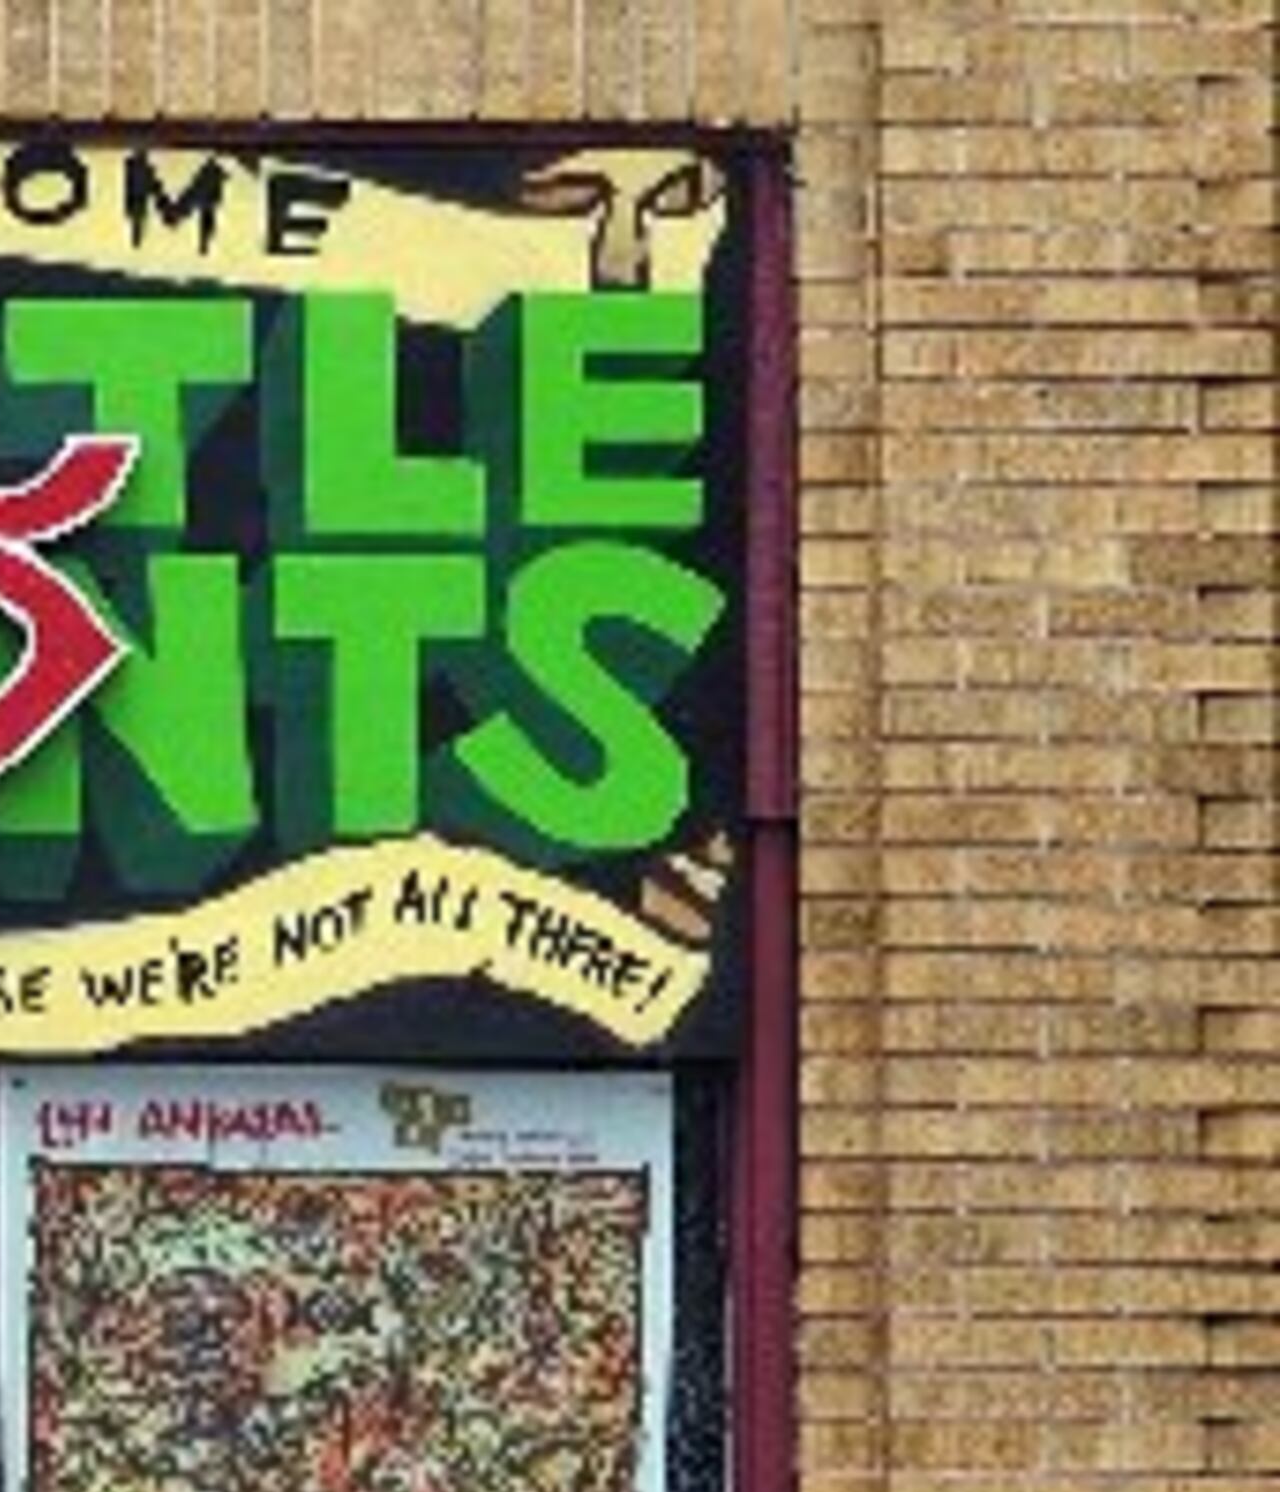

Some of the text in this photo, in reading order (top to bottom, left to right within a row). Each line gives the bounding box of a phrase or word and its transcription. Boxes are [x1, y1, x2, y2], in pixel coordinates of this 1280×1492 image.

[79, 936, 241, 1011] WE'RE
[271, 886, 375, 966] NOT
[391, 868, 480, 932] ALL
[498, 888, 678, 1014] THERE!
